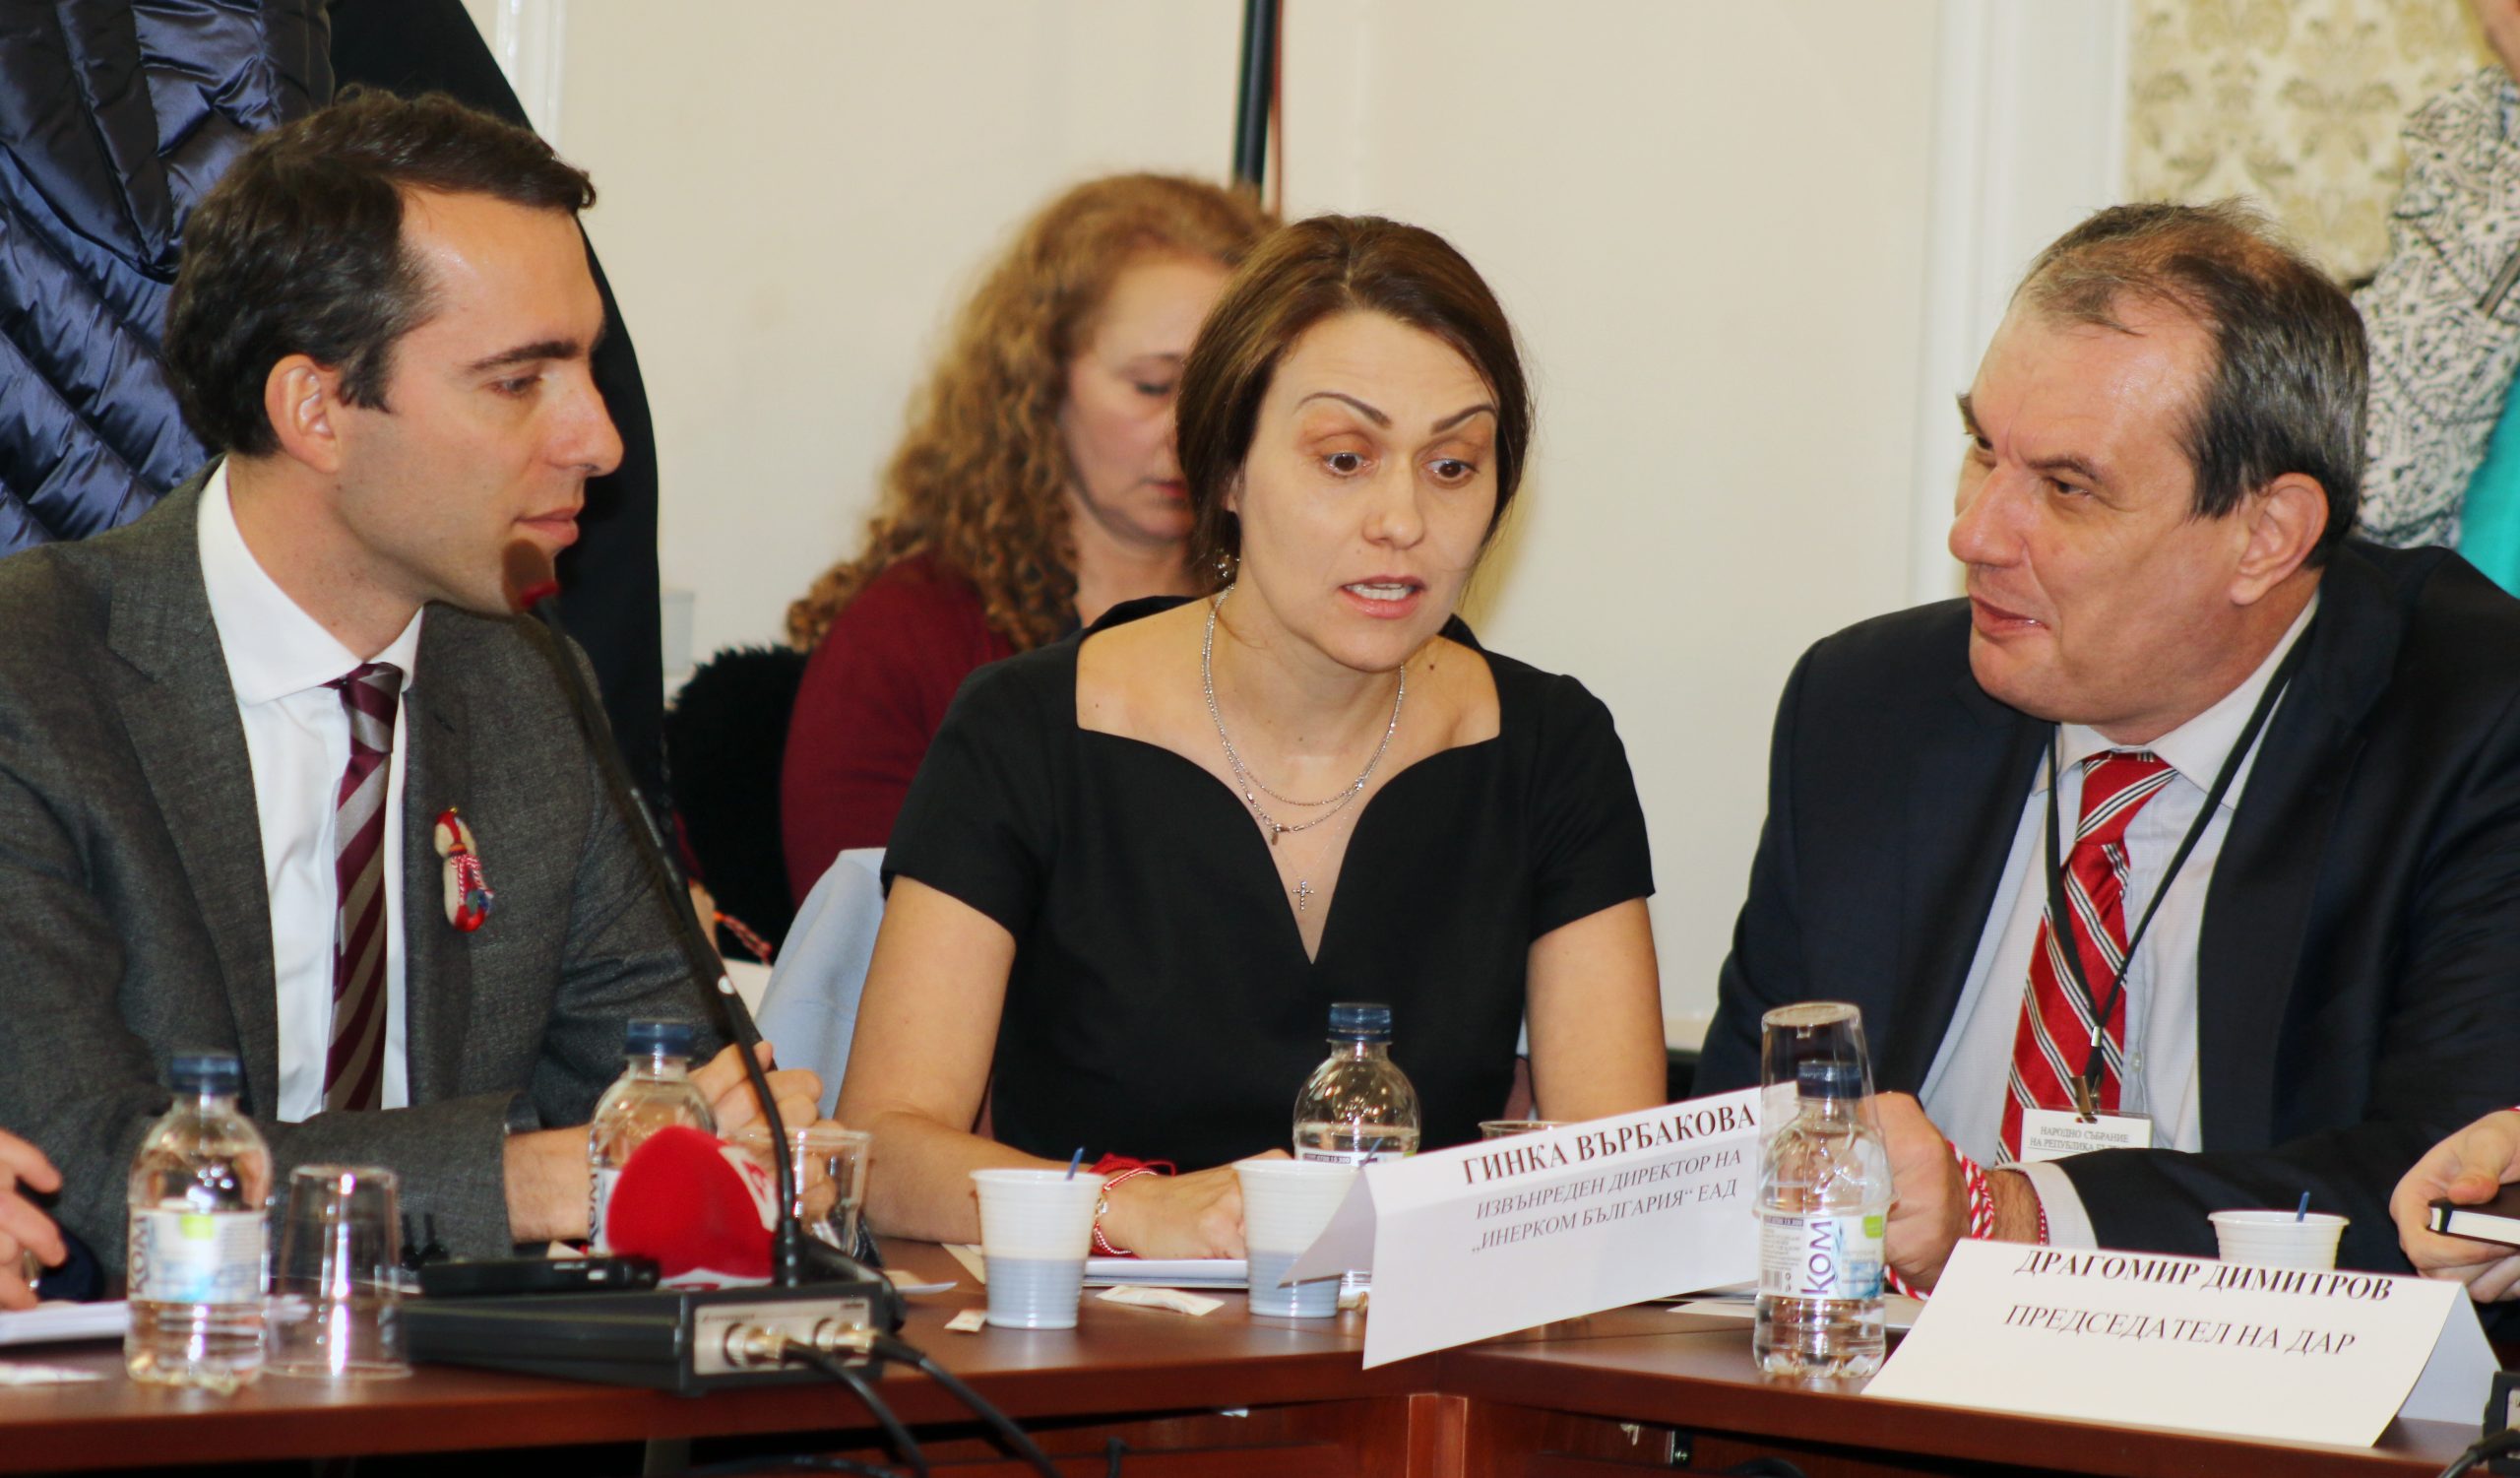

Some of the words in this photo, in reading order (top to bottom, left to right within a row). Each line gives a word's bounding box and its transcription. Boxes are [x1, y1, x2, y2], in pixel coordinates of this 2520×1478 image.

[1462, 1141, 1568, 1185] ГИНКА
[1575, 1103, 1756, 1161] ВЪРБАКОВА
[2030, 1136, 2043, 1147] НА
[2044, 1138, 2094, 1151] РЕПУБЛИКА
[2040, 1125, 2082, 1139] НАРОДНО
[2083, 1130, 2129, 1143] СЪБРАНИЕ
[1476, 1177, 1605, 1220] ИЗВЪНРЕДЕН
[1607, 1155, 1711, 1193] ДИРЕКТОР
[1715, 1149, 1741, 1169] НА
[1472, 1211, 1576, 1253] „ИНЕРКОМ
[1582, 1189, 1693, 1227] БЪЛГАРИЯ“
[1698, 1179, 1737, 1203] ЕАД
[2013, 1250, 2200, 1285] ДРАГОМИР
[2200, 1264, 2393, 1301] ДИМИТРОВ
[2004, 1305, 2233, 1344] ПРЕДСЕДАТЕЛ
[2236, 1325, 2279, 1349] НА
[2284, 1329, 2356, 1357] ДАР
